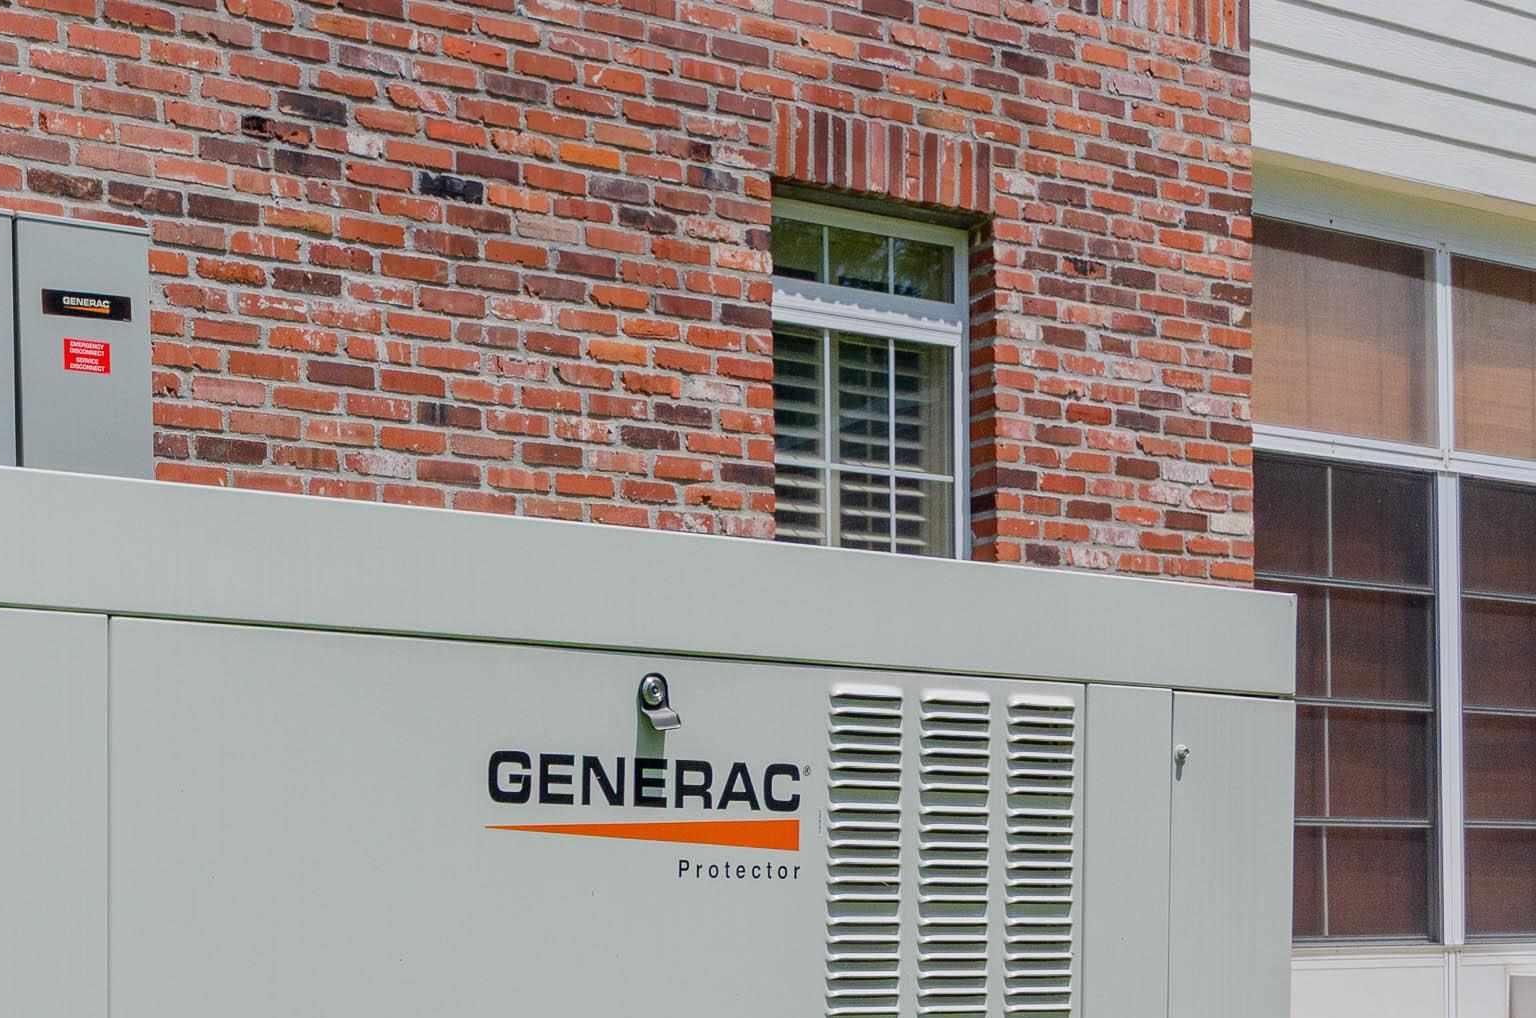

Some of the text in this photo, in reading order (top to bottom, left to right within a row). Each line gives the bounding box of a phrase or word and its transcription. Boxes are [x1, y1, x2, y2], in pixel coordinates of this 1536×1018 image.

[63, 296, 111, 309] GENERAC
[70, 341, 104, 350] EMERGENCY
[69, 347, 105, 357] DISCONNECT
[69, 363, 105, 372] DISCONNECT
[488, 750, 801, 812] GENERAC
[678, 859, 801, 880] Protector
